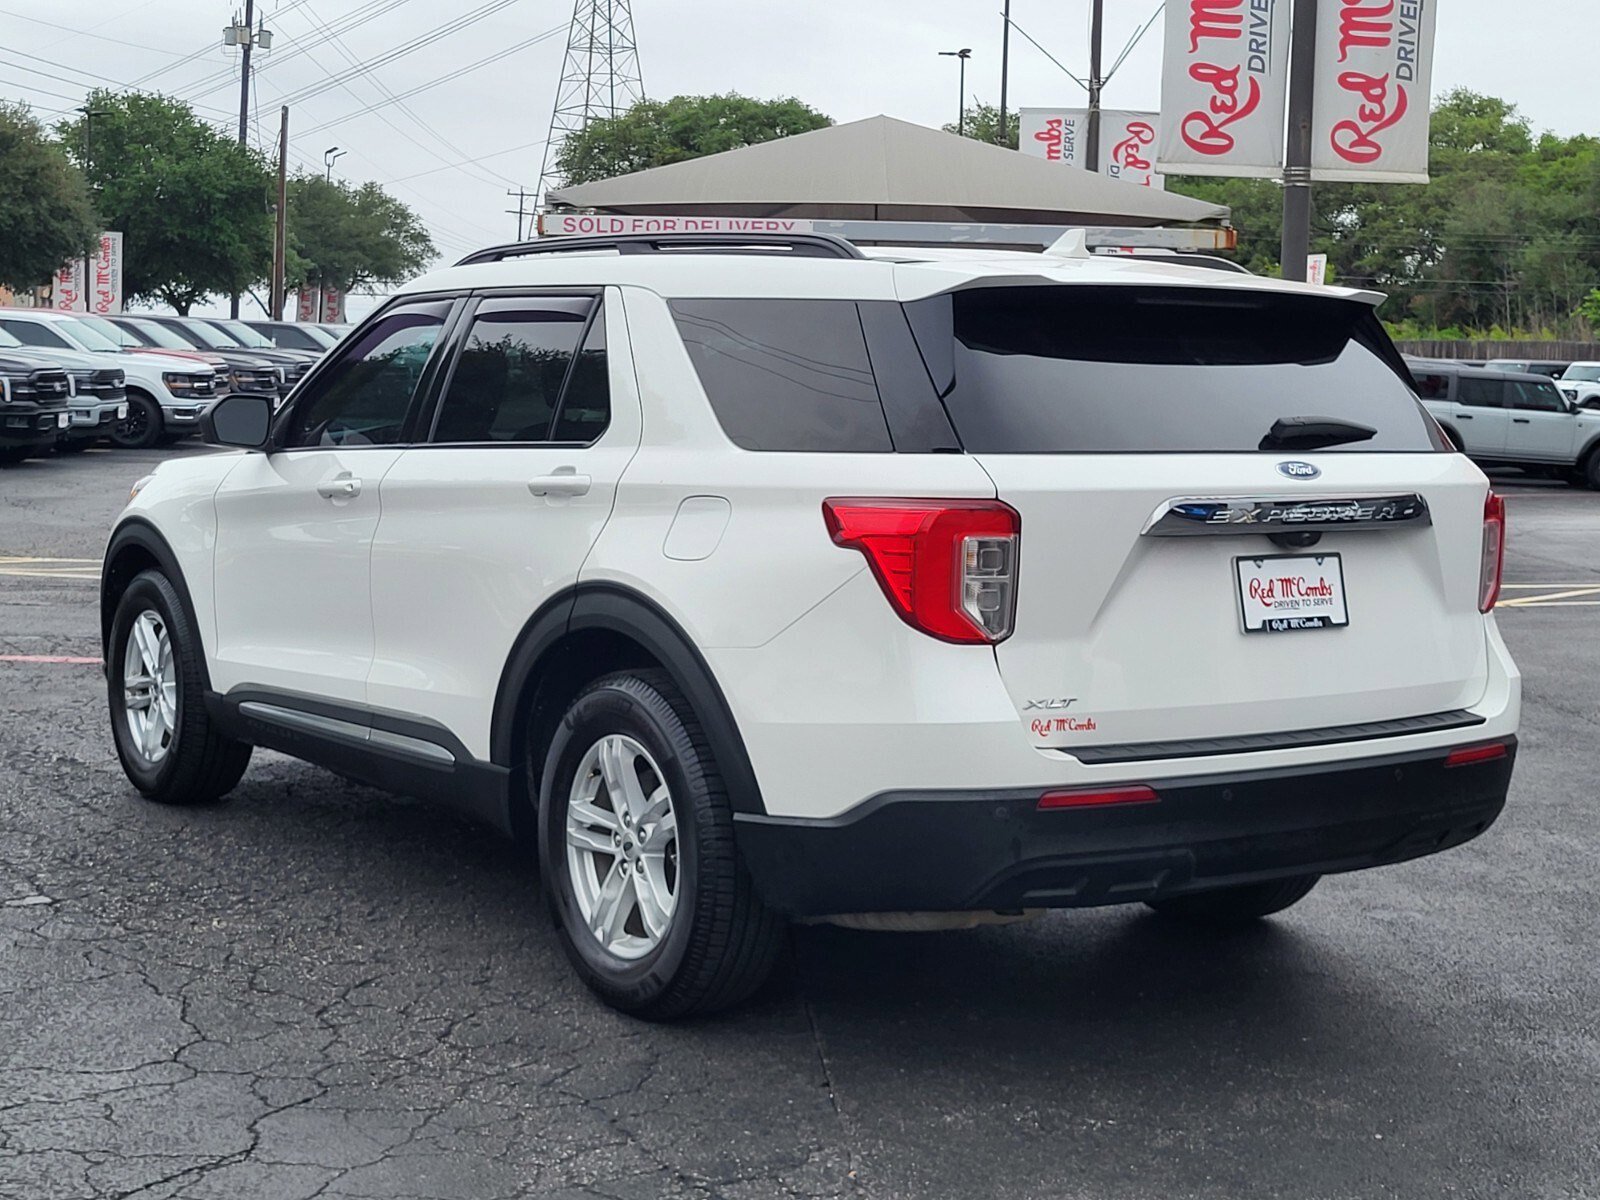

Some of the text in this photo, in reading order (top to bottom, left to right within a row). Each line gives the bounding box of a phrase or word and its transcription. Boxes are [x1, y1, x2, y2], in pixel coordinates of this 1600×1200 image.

[1247, 0, 1269, 74] DRIVE
[1396, 0, 1417, 82] DRIVE
[1181, 62, 1260, 155] Red
[1330, 71, 1408, 164] Red
[1063, 118, 1075, 160] SERVE
[1112, 121, 1155, 170] Red
[563, 217, 795, 233] SOLD FOR DELIVERY
[95, 290, 115, 312] Red
[1249, 577, 1276, 607] Red
[1273, 598, 1333, 609] DRIVEN TO SERVE
[1022, 698, 1078, 710] XLT
[1031, 718, 1051, 737] Red
